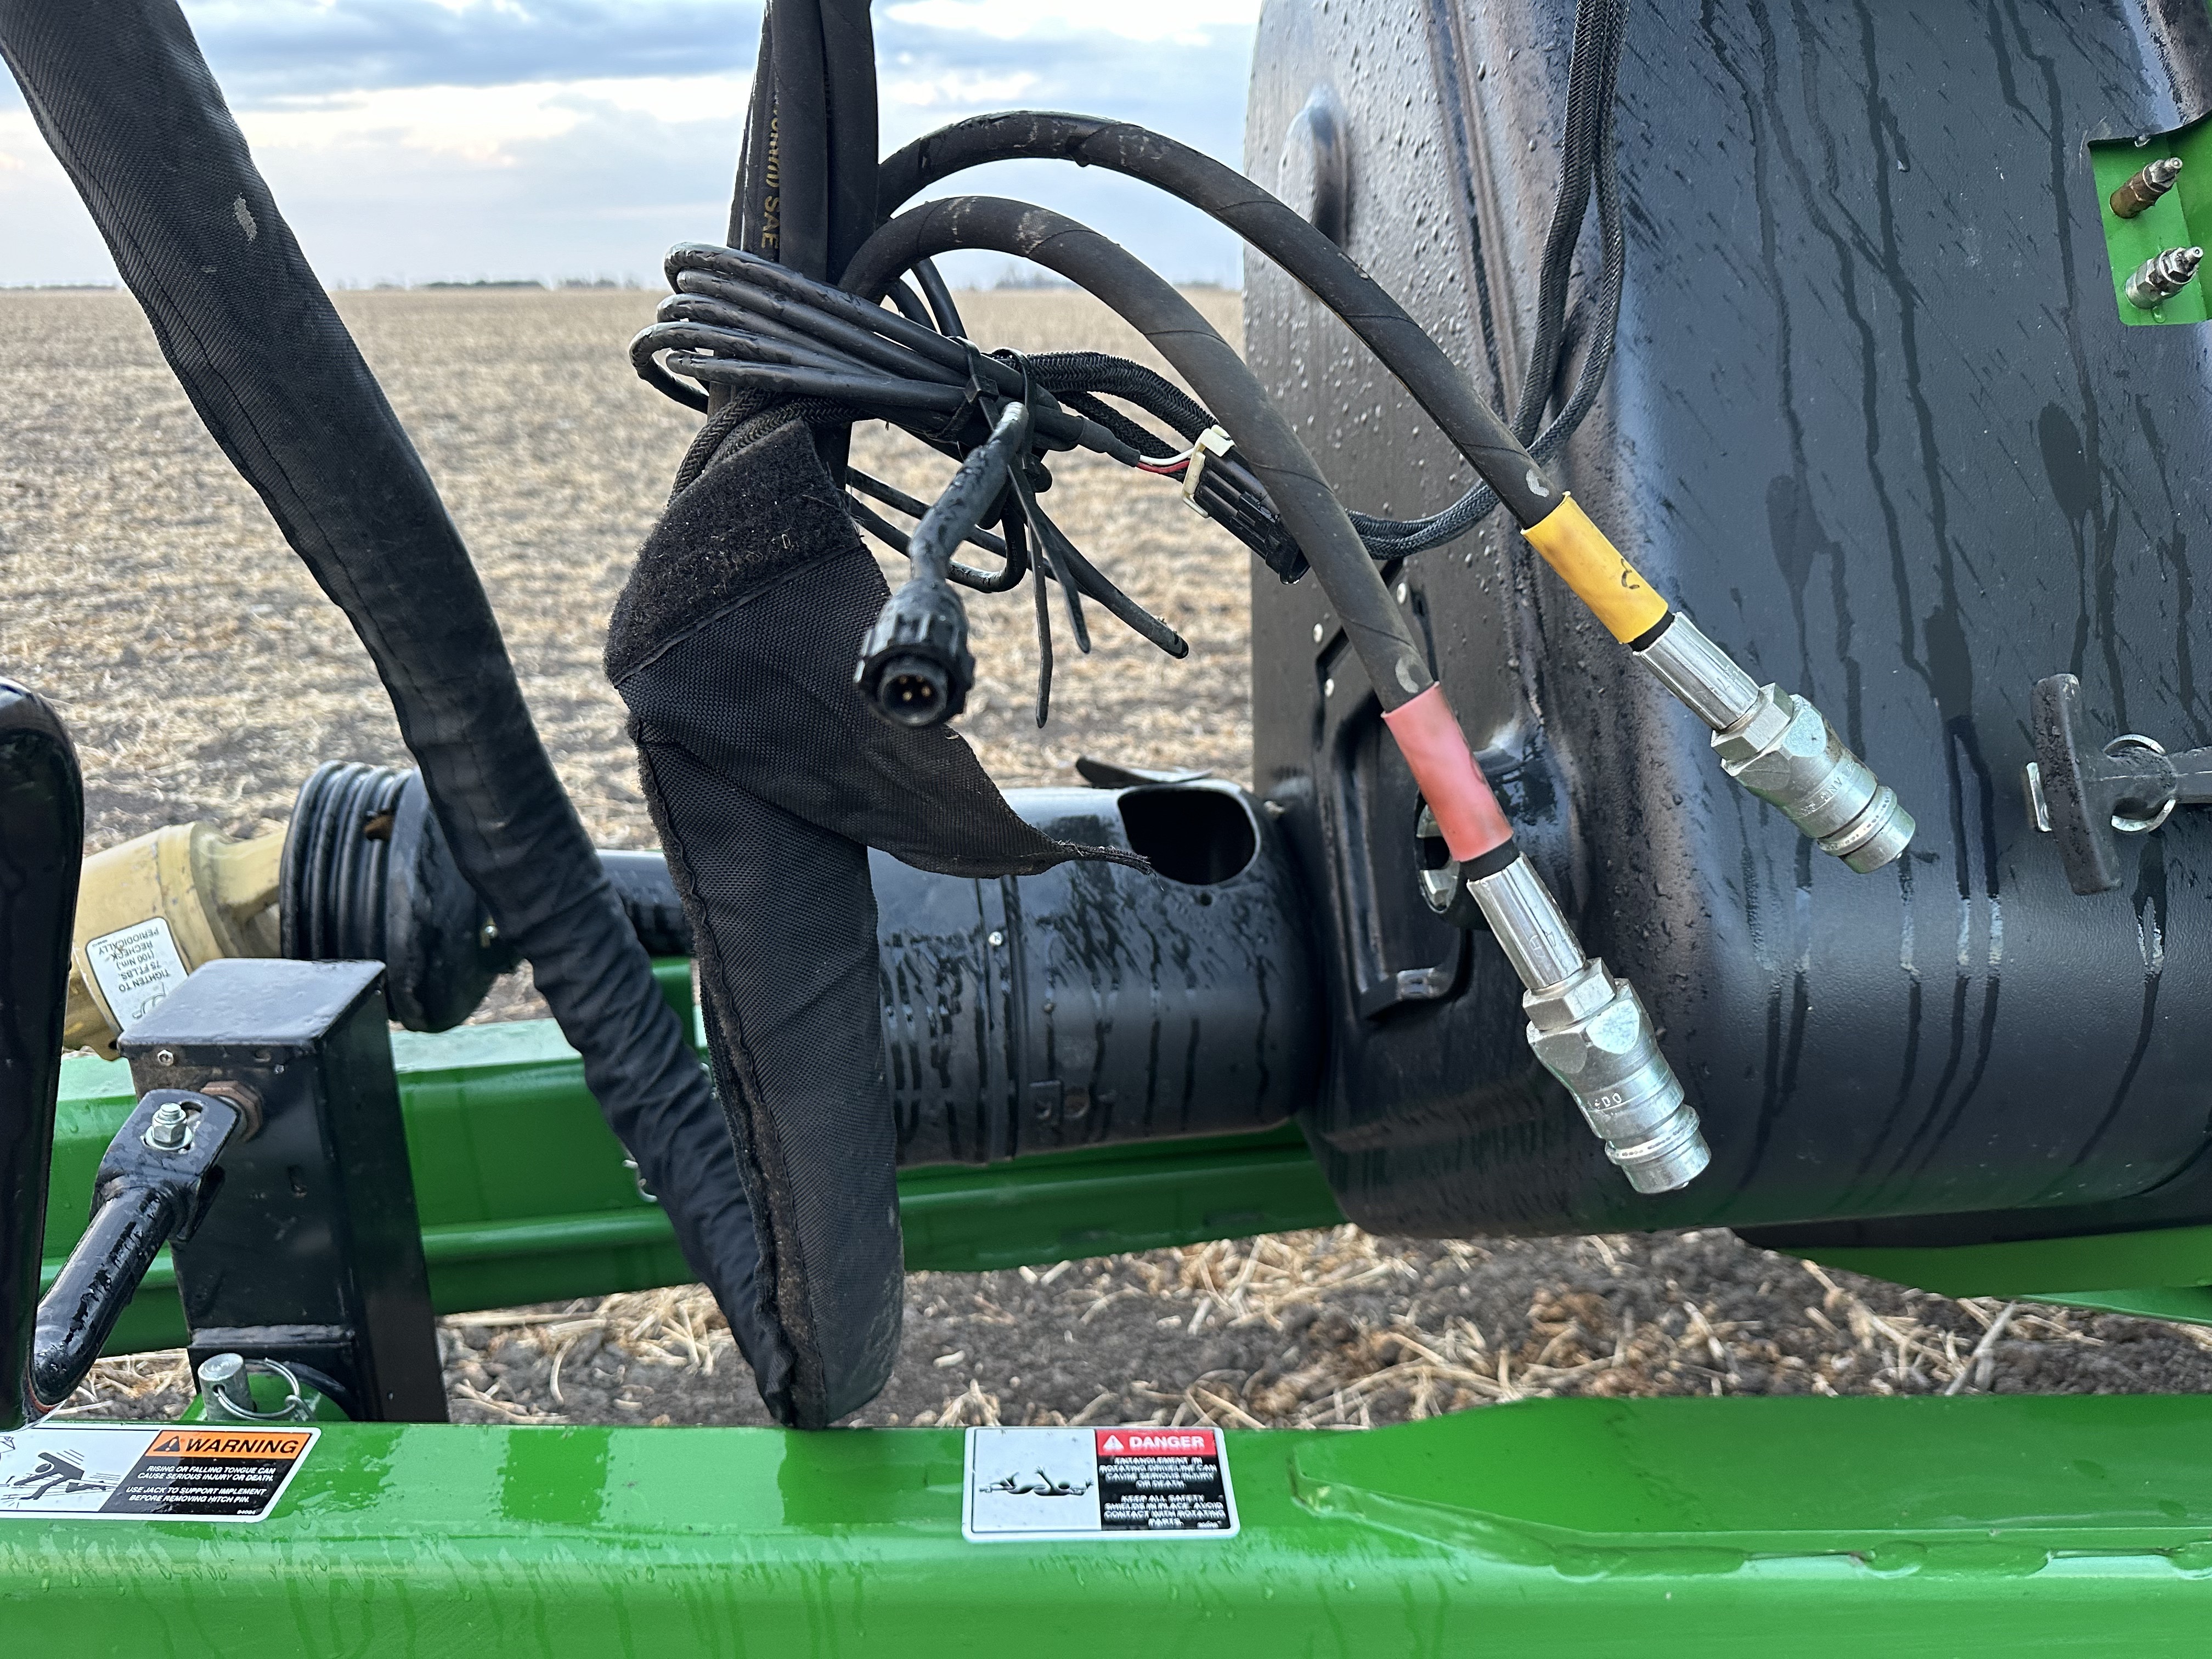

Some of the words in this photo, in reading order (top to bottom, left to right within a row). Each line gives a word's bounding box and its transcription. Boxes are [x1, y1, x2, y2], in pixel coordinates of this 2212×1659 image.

[761, 195, 780, 249] SAE
[98, 927, 160, 956] PERIODICALLY
[111, 940, 154, 962] RECHECK
[137, 949, 155, 963] (100
[150, 960, 162, 970] 75
[132, 968, 171, 988] TIGHTEN
[119, 982, 133, 993] TO
[186, 1438, 300, 1454] WARNING
[1129, 1435, 1205, 1449] DANGER
[1105, 1472, 1138, 1481] CAUSE
[1138, 1472, 1180, 1481] SERIOUS
[1181, 1472, 1214, 1481] INJURY
[1136, 1480, 1151, 1489] OR
[1167, 1494, 1205, 1503] SAFETY
[1104, 1510, 1149, 1519] CONTACT
[1176, 1510, 1226, 1519] ROTATING
